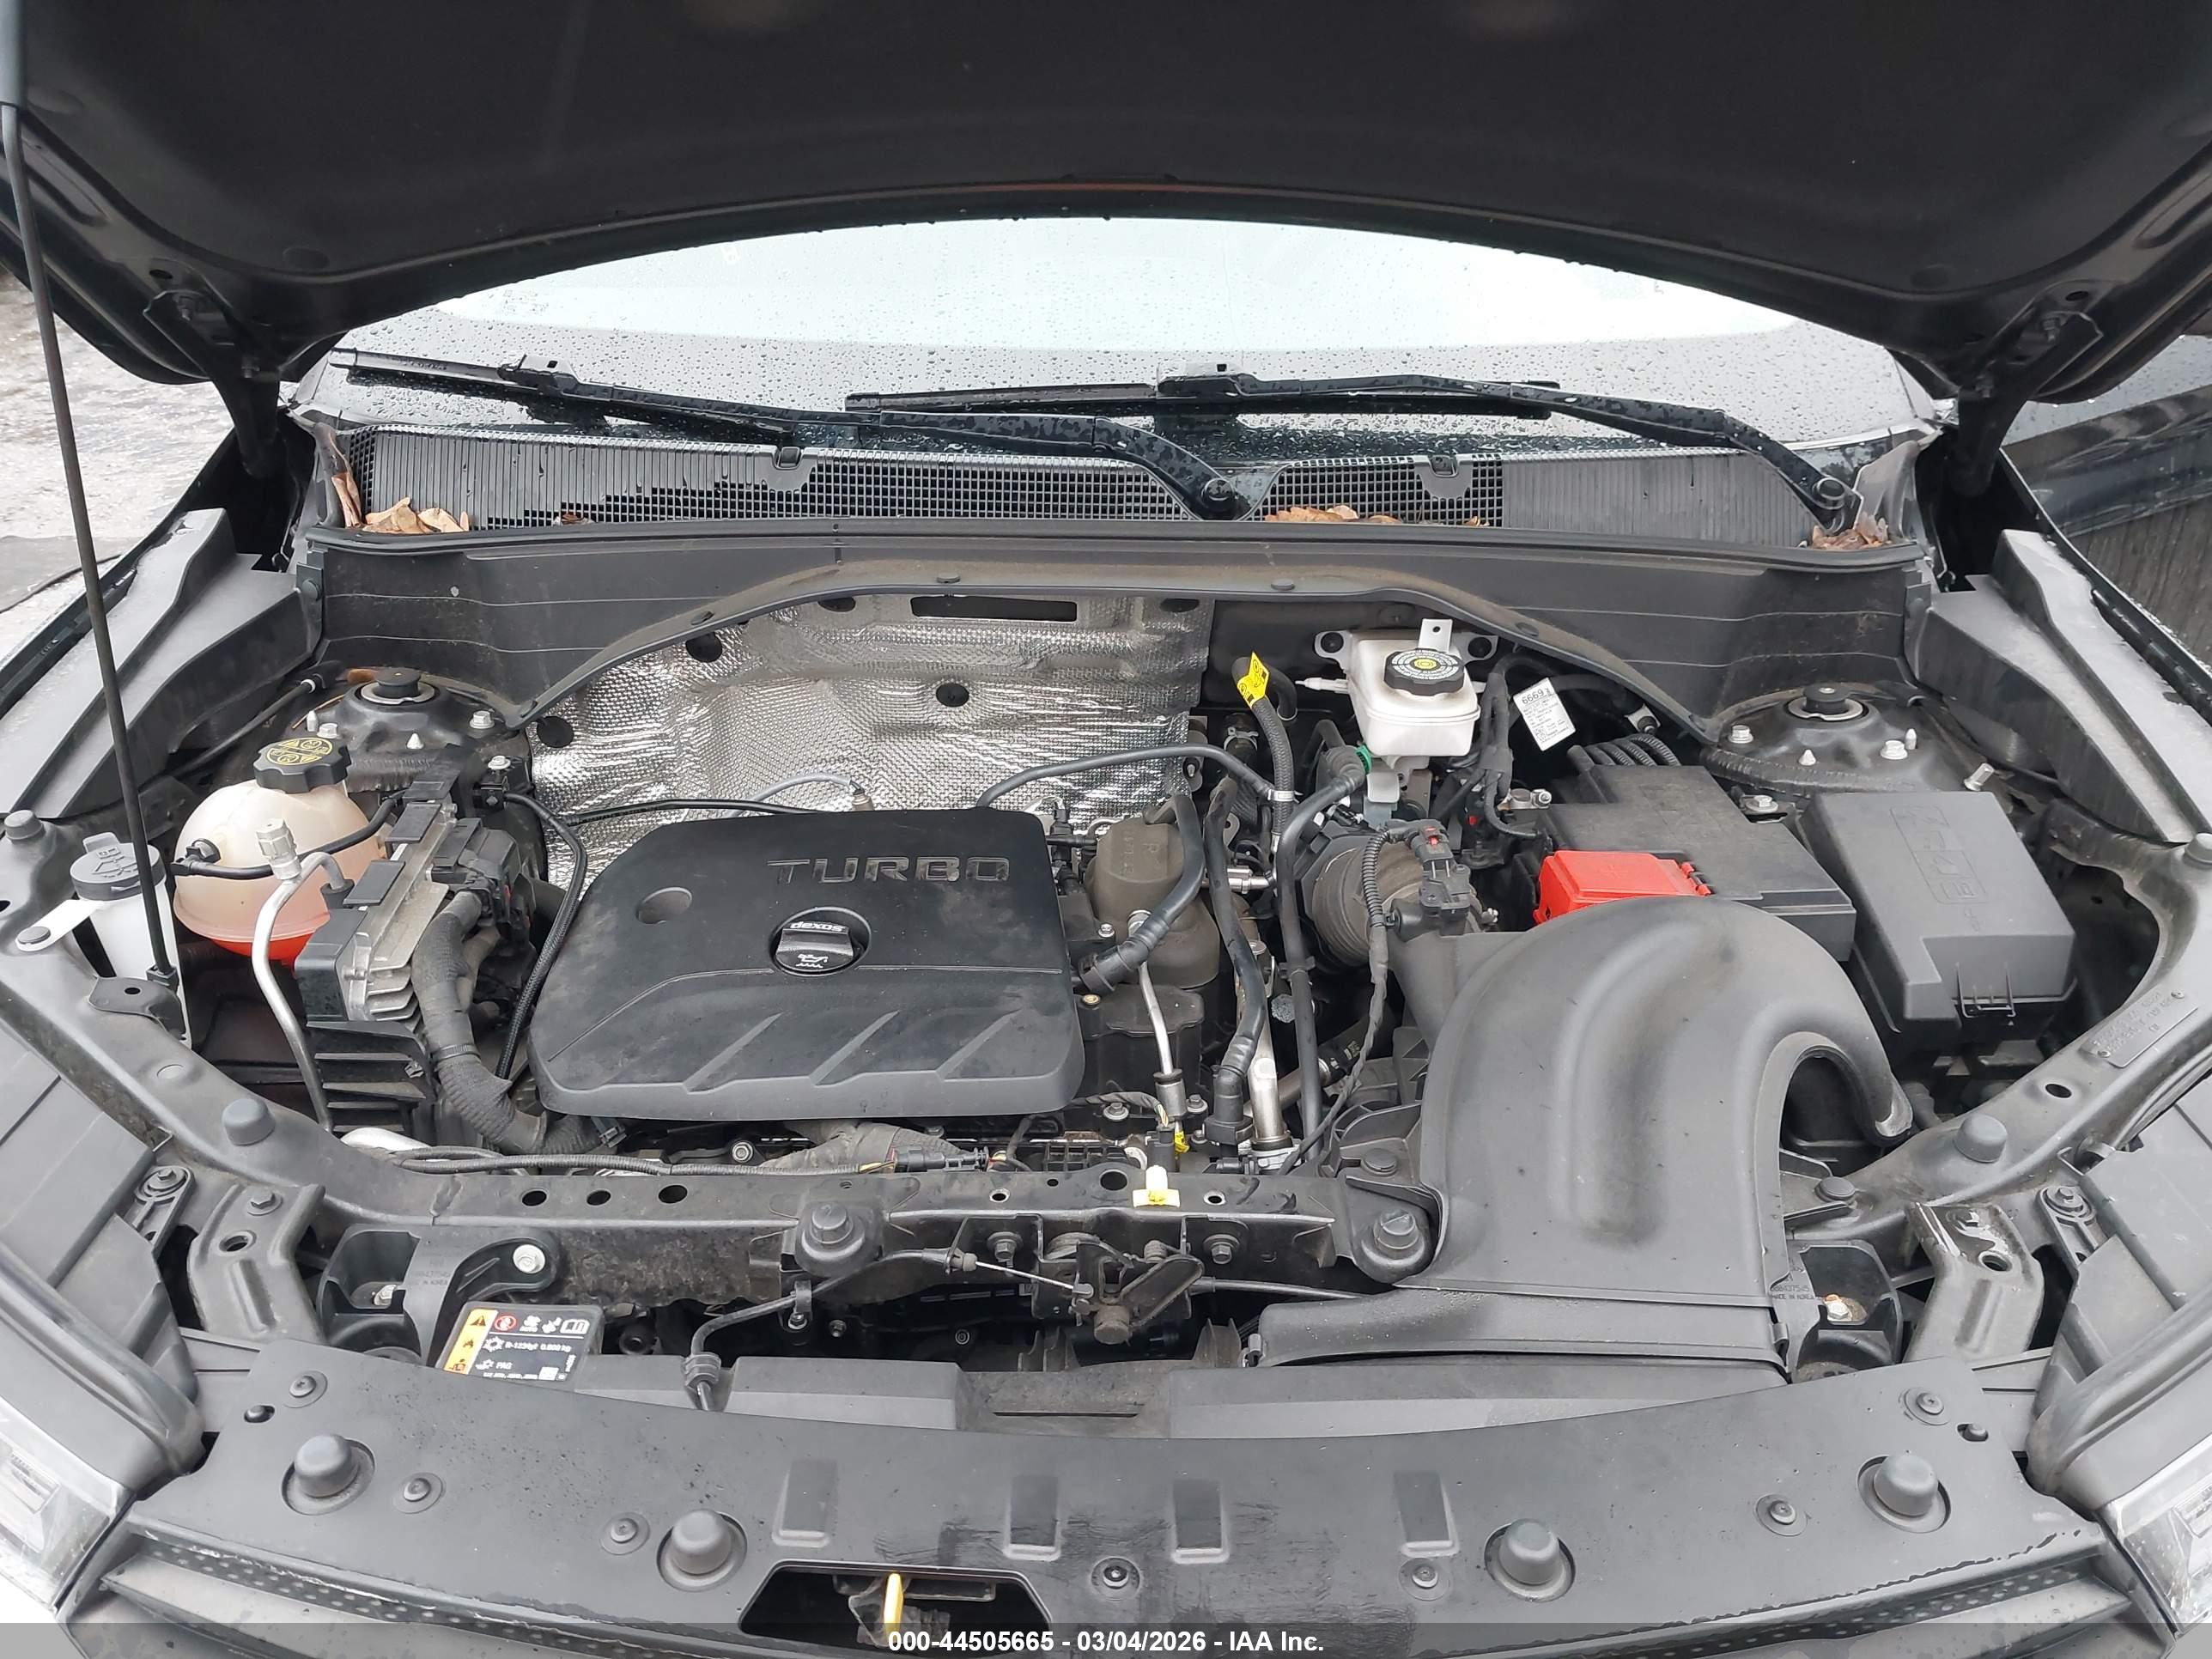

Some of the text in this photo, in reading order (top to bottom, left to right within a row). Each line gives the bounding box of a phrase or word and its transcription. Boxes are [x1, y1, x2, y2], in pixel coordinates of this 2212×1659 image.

[1522, 689, 1545, 705] 6669
[768, 857, 1010, 884] TURBO
[790, 921, 845, 933] dexos
[495, 1361, 513, 1370] PAG
